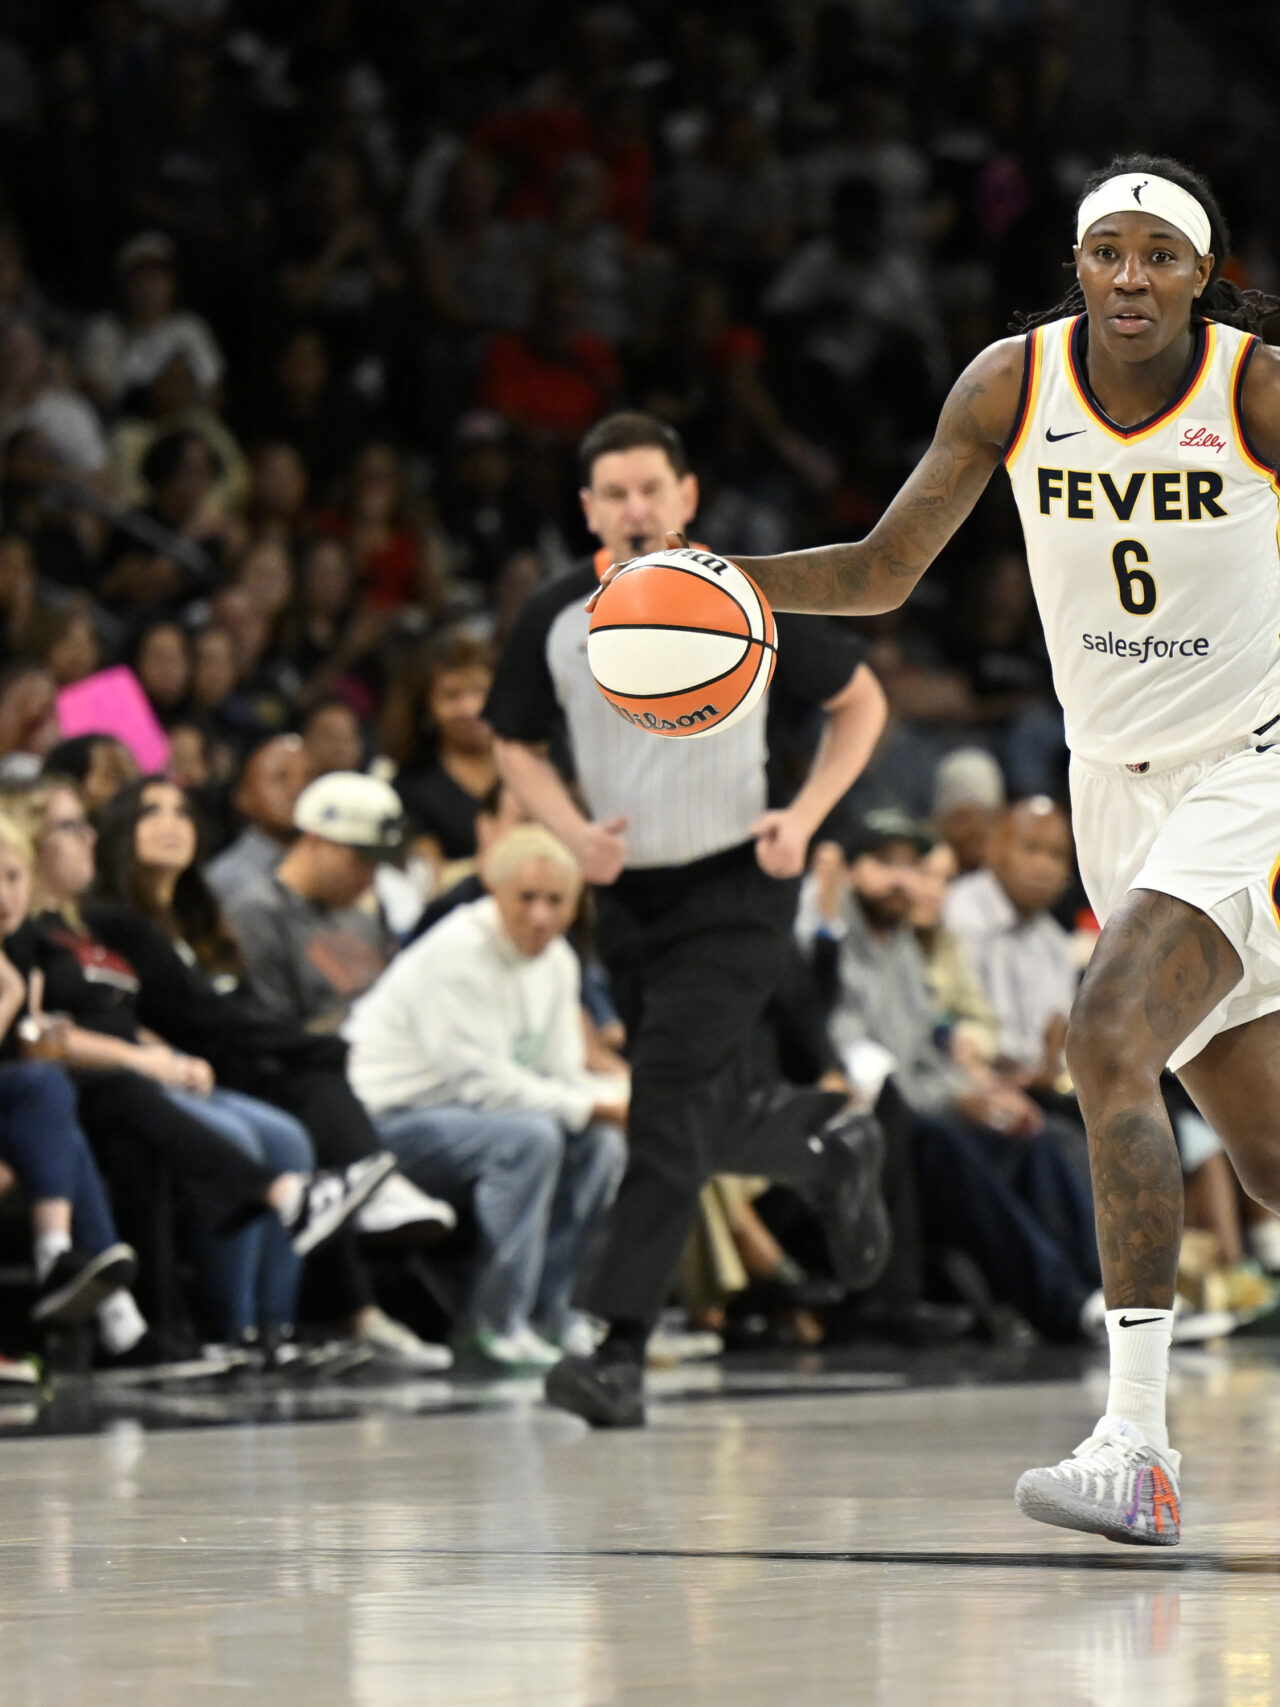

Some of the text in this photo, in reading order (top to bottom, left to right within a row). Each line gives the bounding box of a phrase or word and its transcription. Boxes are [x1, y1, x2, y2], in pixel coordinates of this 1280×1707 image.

[1178, 427, 1227, 454] Lilly
[1037, 466, 1231, 523] FEVER
[1111, 537, 1158, 618] 6
[1082, 631, 1210, 664] salesforce
